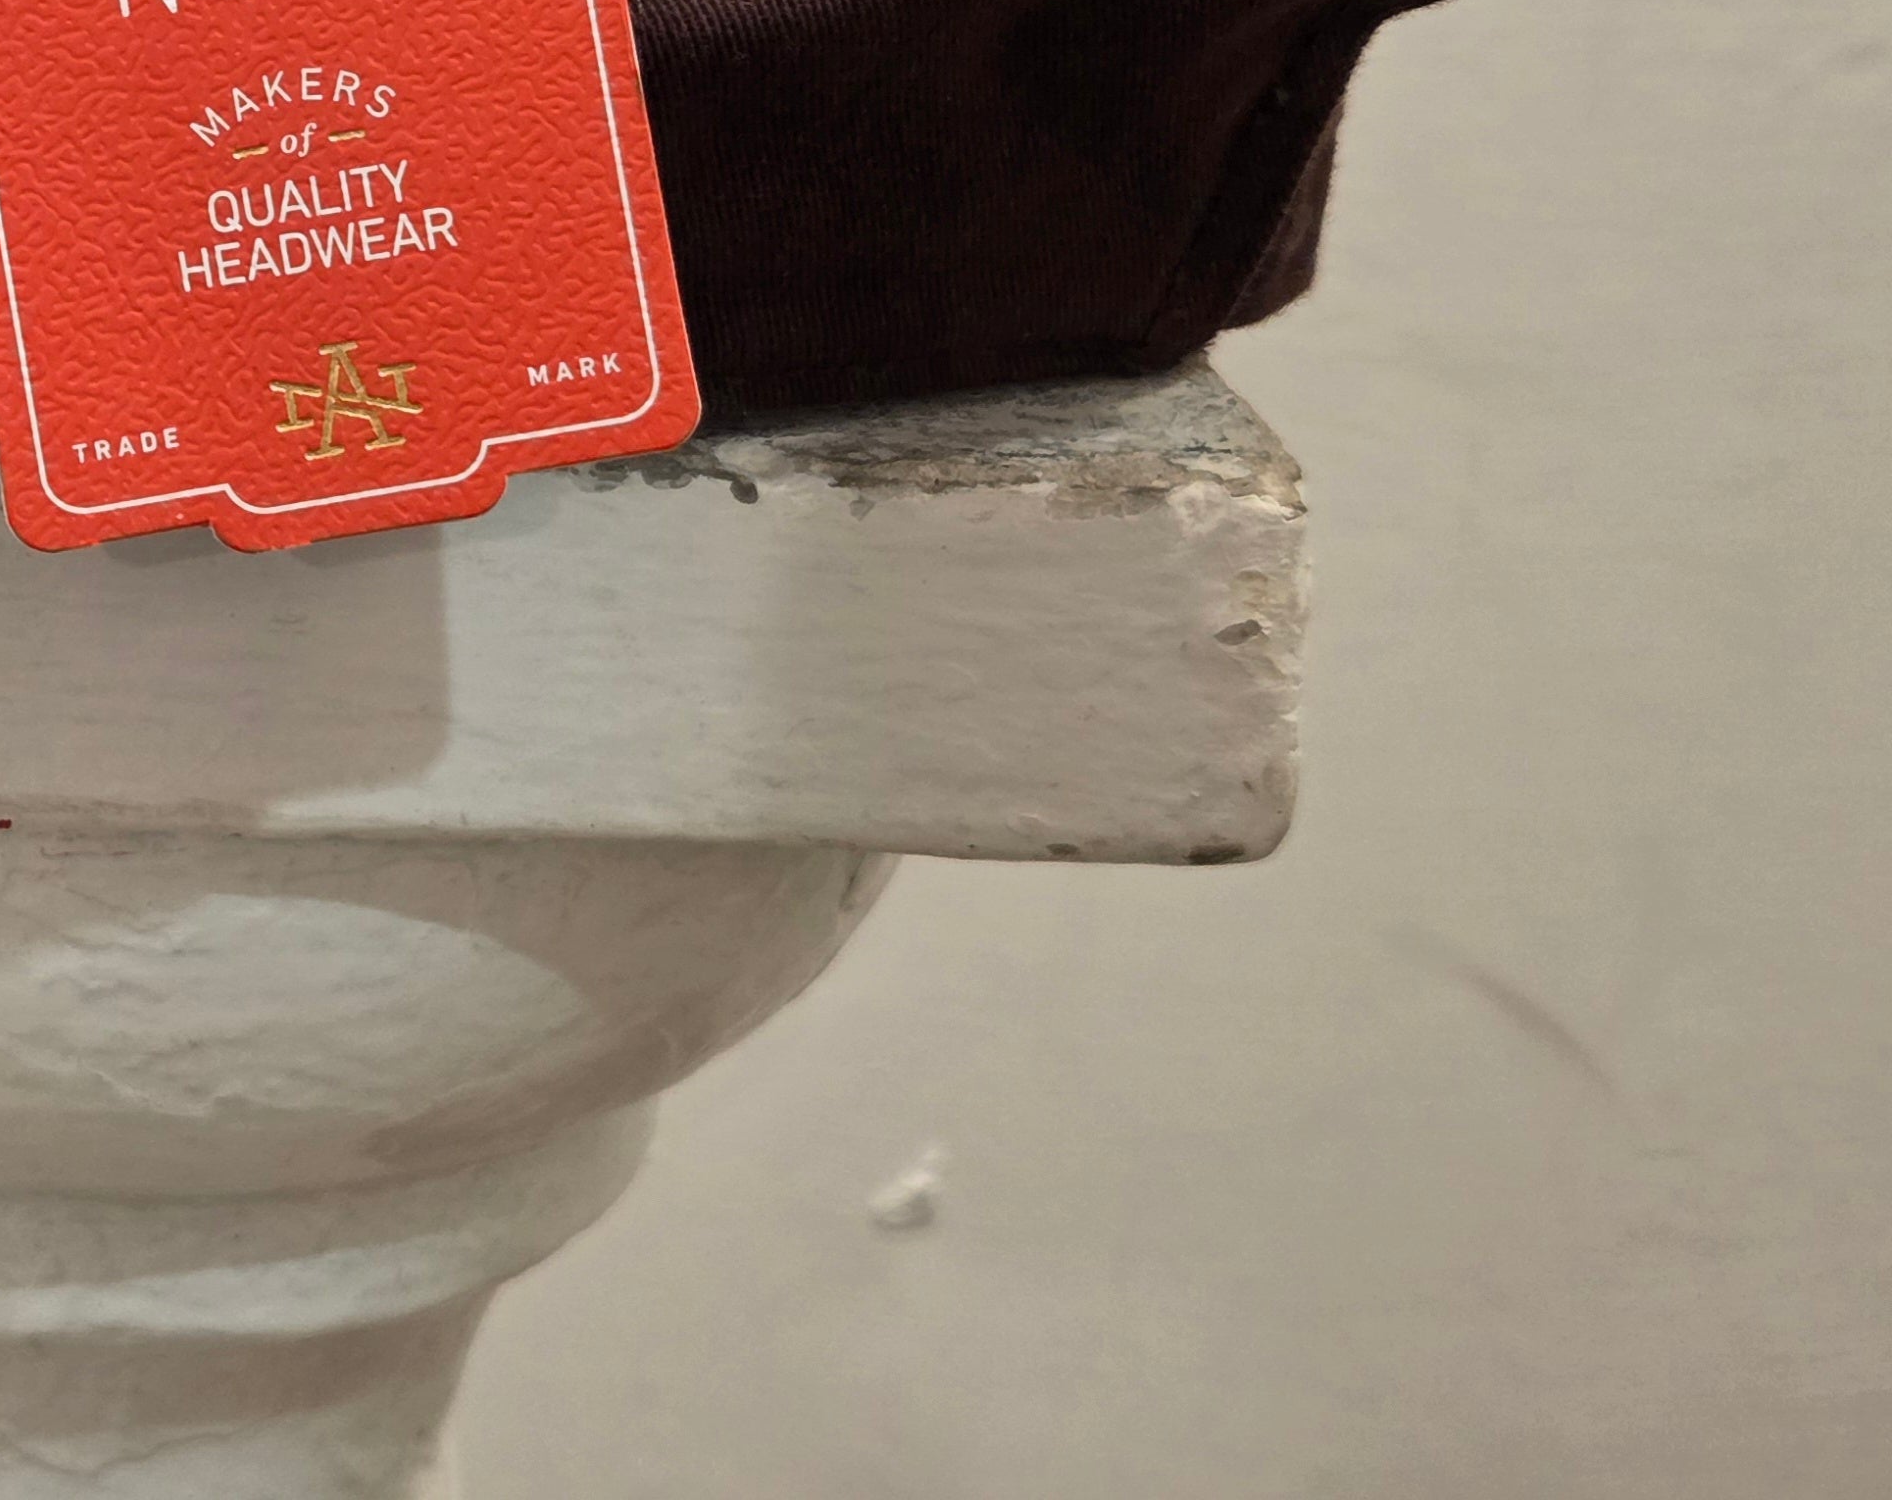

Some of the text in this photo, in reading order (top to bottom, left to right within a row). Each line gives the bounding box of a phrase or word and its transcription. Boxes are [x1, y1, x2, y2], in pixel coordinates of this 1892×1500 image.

[189, 67, 397, 147] MAKERS
[280, 123, 317, 158] of
[207, 160, 409, 234] QUALITY
[177, 206, 458, 292] HEADWEAR
[527, 352, 622, 387] MARK
[72, 427, 181, 465] TRADE
